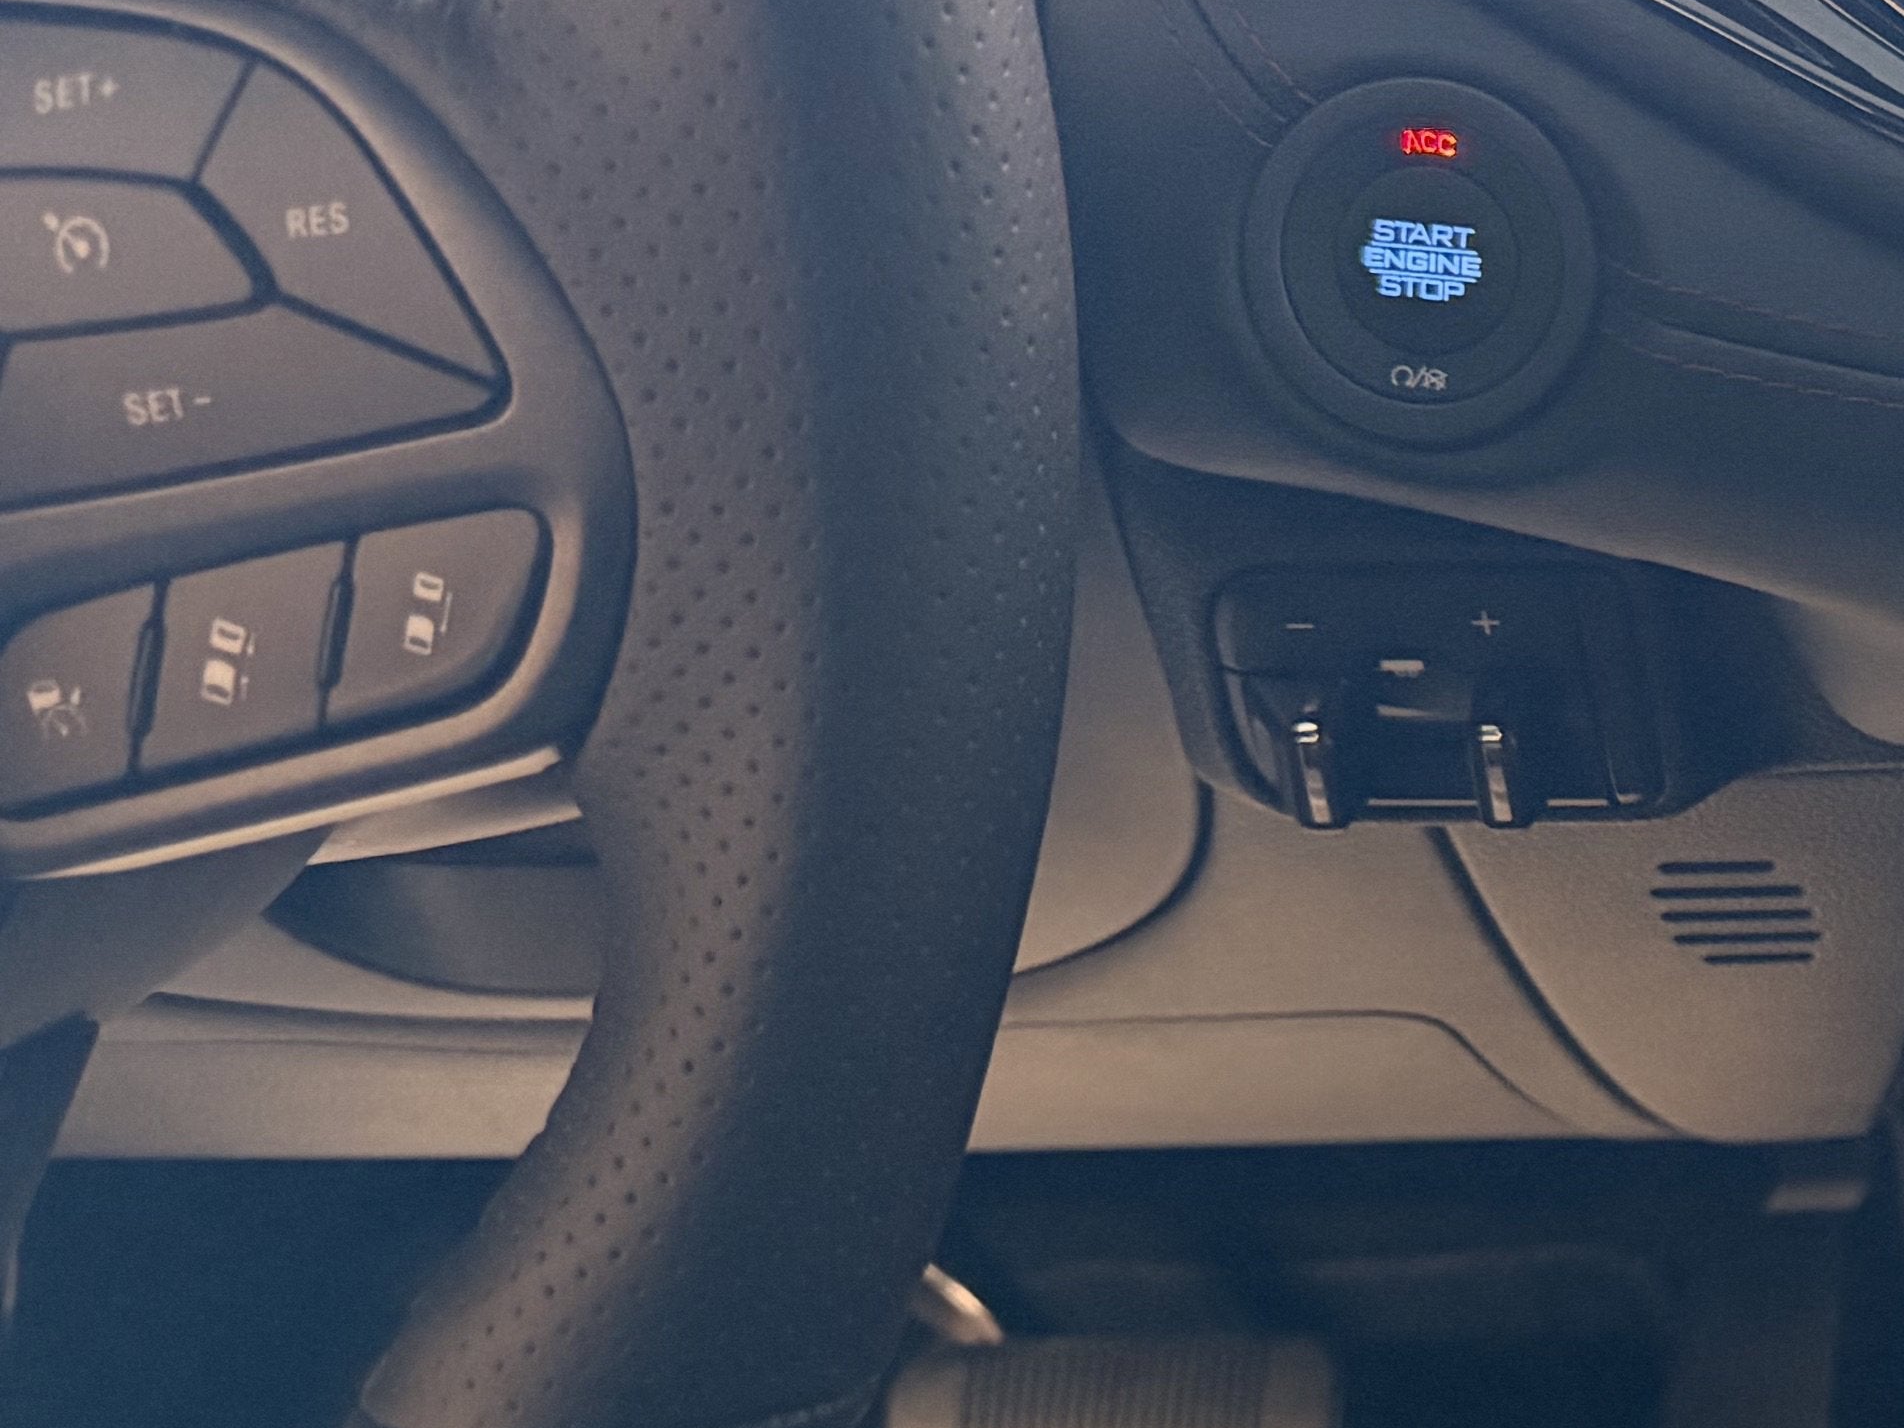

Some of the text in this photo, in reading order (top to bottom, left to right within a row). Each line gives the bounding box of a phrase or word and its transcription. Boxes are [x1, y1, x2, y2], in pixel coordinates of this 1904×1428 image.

[1402, 128, 1458, 157] ACC
[285, 201, 350, 238] RES
[1372, 218, 1476, 248] START
[1362, 245, 1483, 278] ENGINE
[1376, 275, 1466, 302] STOP
